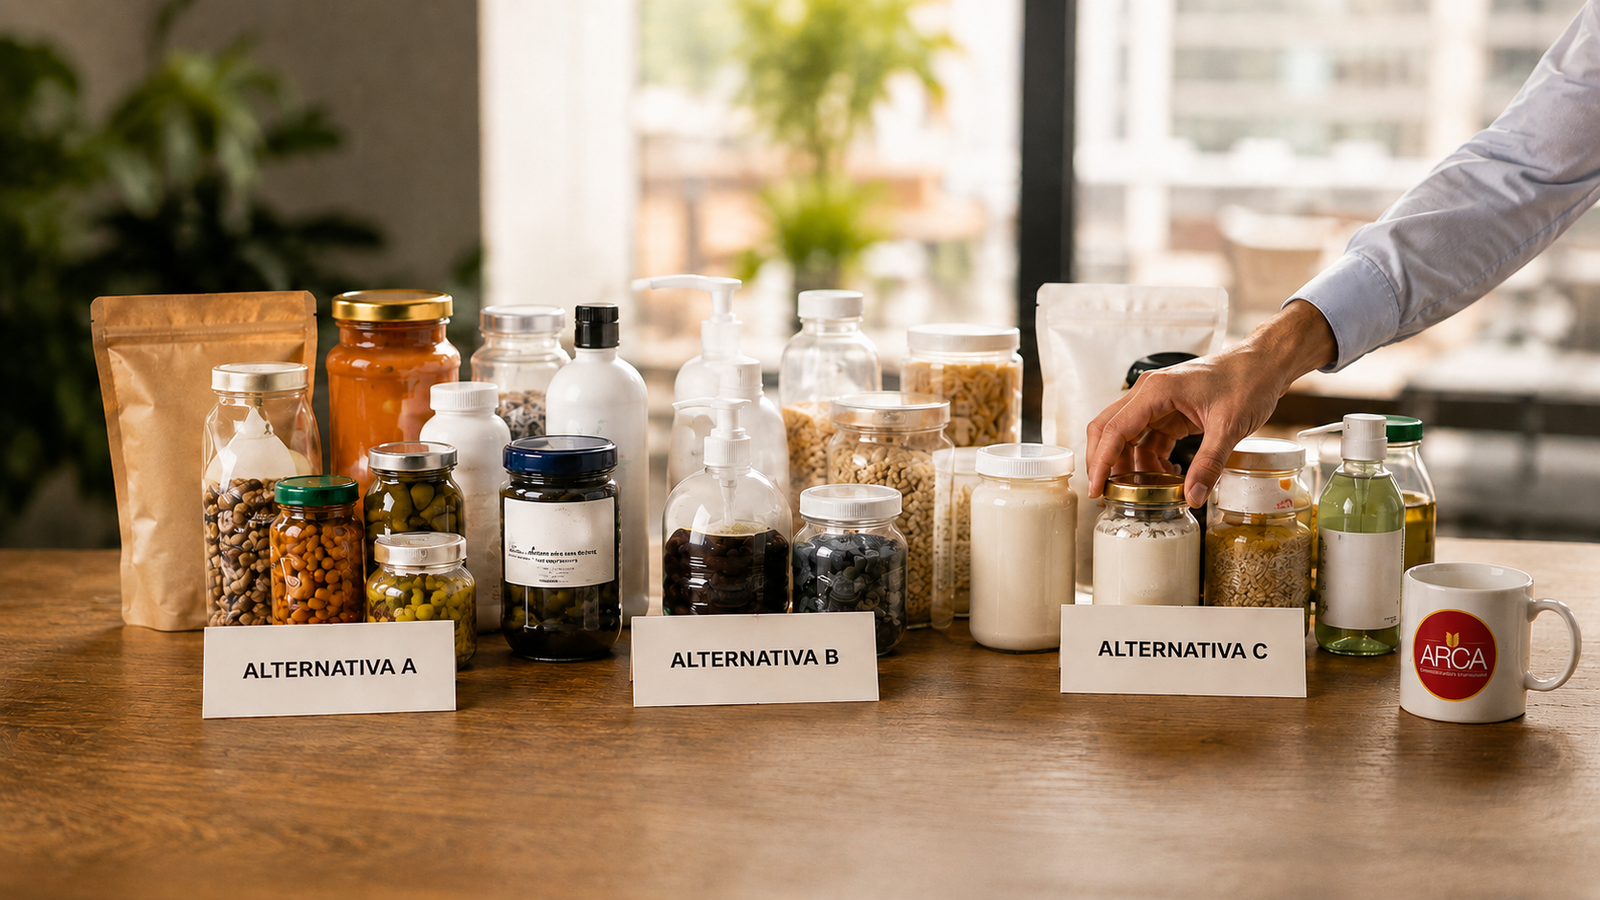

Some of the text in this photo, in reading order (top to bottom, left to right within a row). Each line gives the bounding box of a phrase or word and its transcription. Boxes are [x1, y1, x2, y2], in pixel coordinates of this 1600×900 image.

[670, 648, 839, 669] ALTERNATIVA B
[1098, 640, 1268, 660] ALTERNATIVA C
[1420, 644, 1488, 670] ARCA
[242, 657, 418, 680] ALTERNATIVA A
